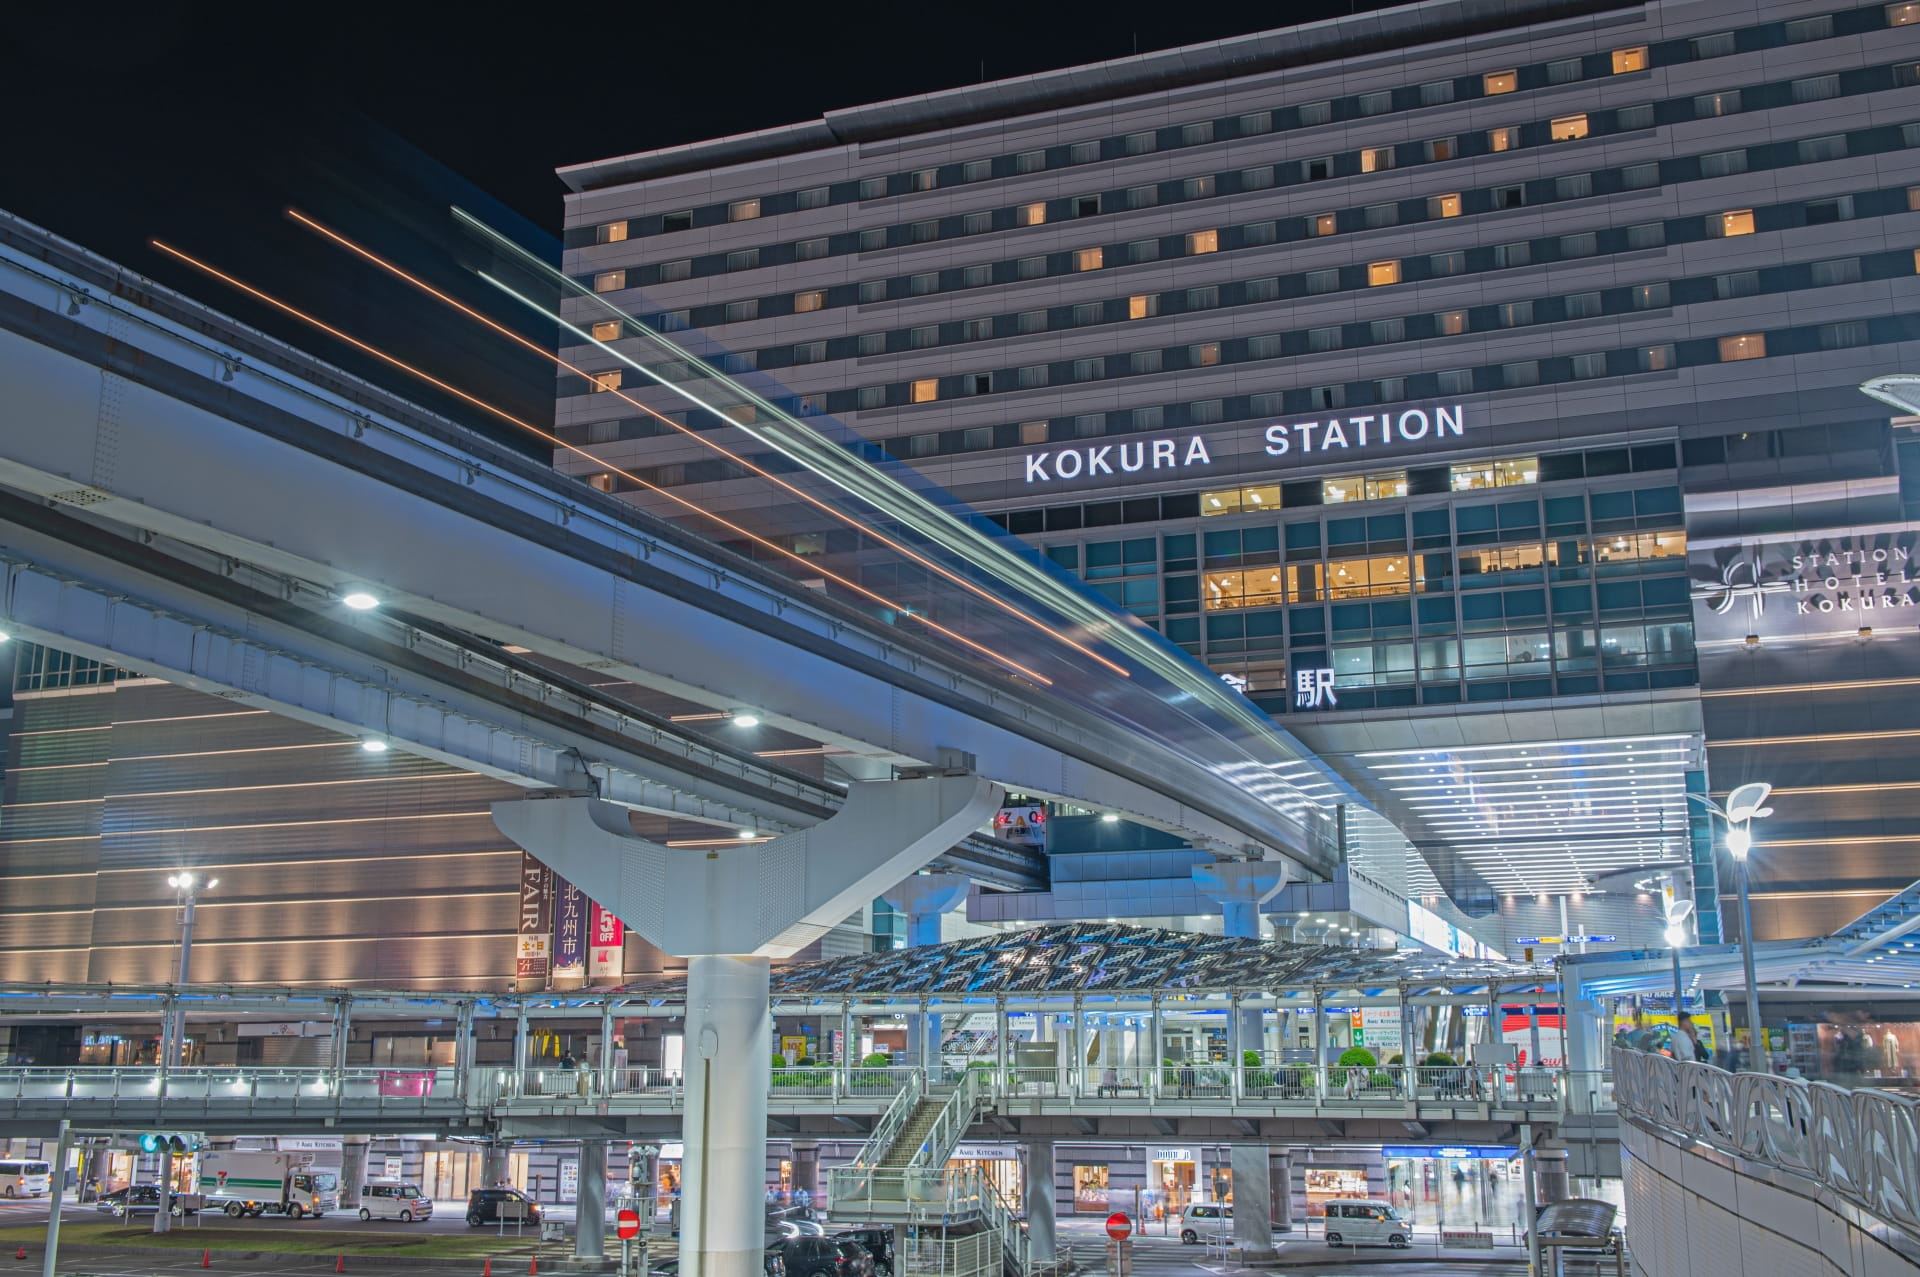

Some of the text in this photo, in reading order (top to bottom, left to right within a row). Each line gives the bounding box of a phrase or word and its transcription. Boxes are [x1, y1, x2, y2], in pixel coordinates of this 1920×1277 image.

[1025, 404, 1466, 483] KOKURA STATION
[1792, 546, 1908, 570] STATION
[1795, 571, 1911, 593] HOTEL
[1797, 593, 1915, 616] KOKURA
[1296, 668, 1338, 708] 駅
[522, 868, 541, 932] FAIR
[561, 883, 580, 956] 北九州市
[599, 933, 614, 942] OFF
